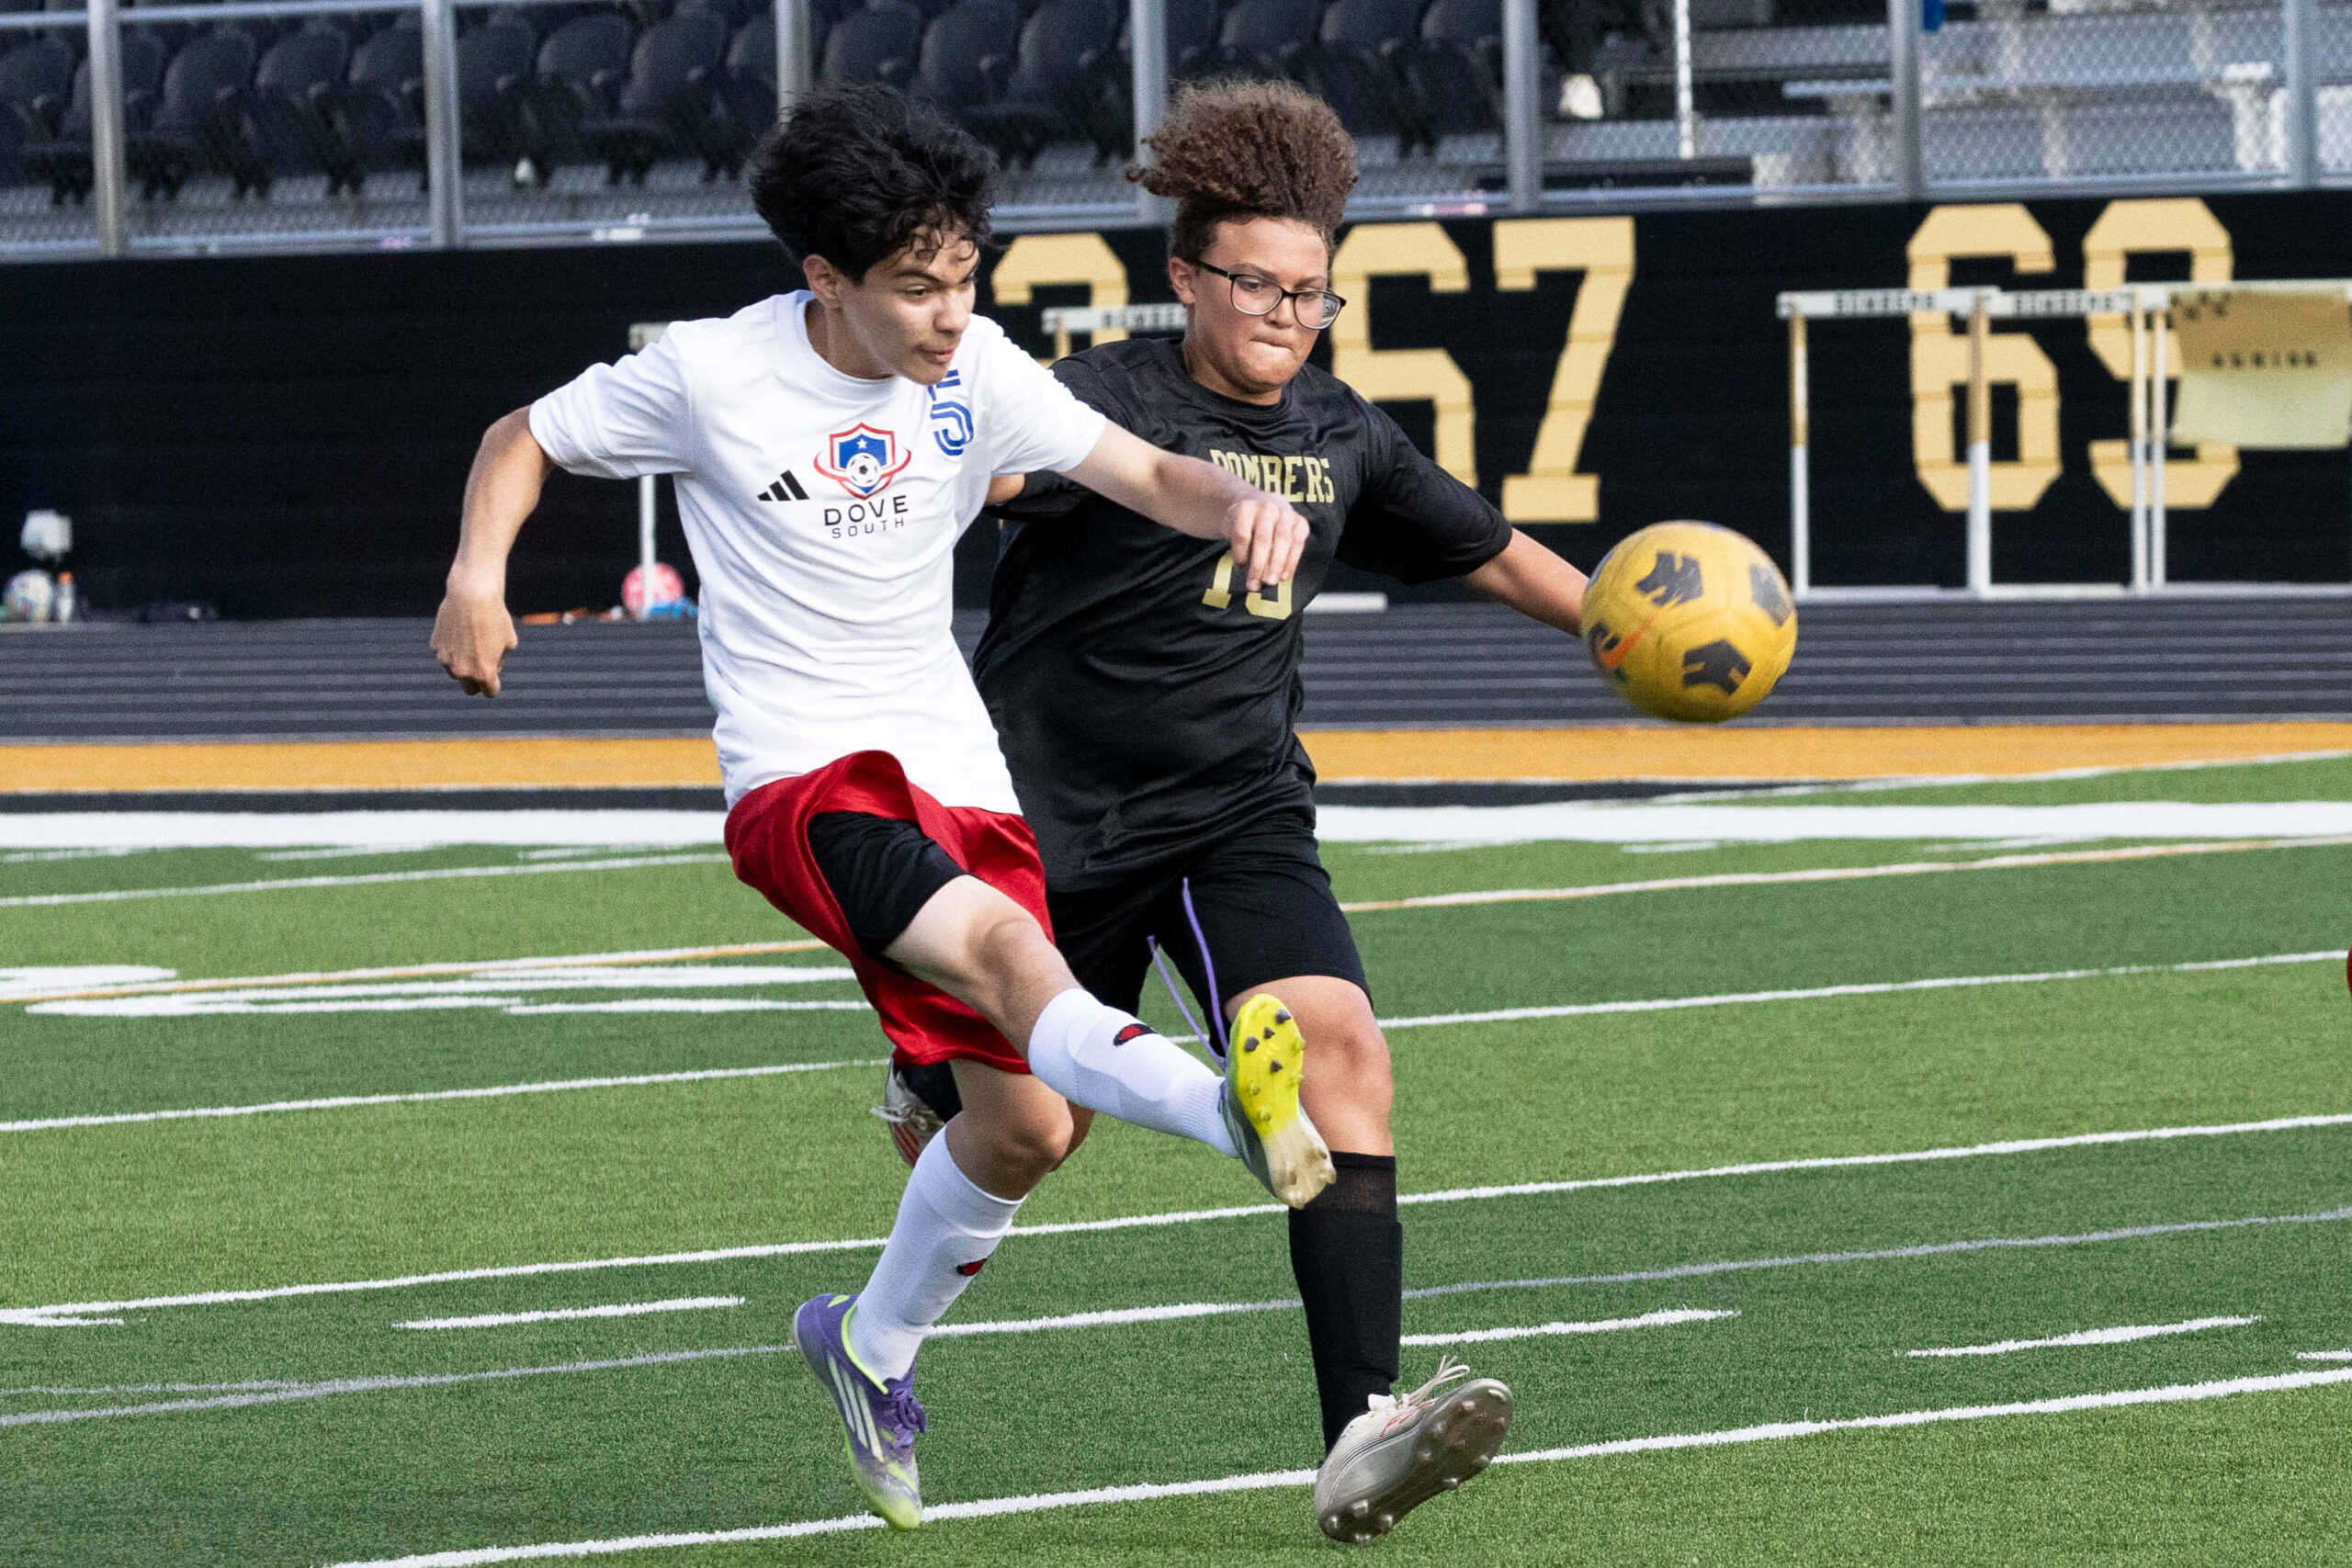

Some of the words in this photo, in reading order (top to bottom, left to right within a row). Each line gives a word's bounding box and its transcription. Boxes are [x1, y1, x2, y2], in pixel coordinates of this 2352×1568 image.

[1329, 216, 1635, 523] 67
[1906, 197, 2241, 511] 69
[824, 495, 909, 526] DOVE
[831, 517, 905, 539] SOUTH
